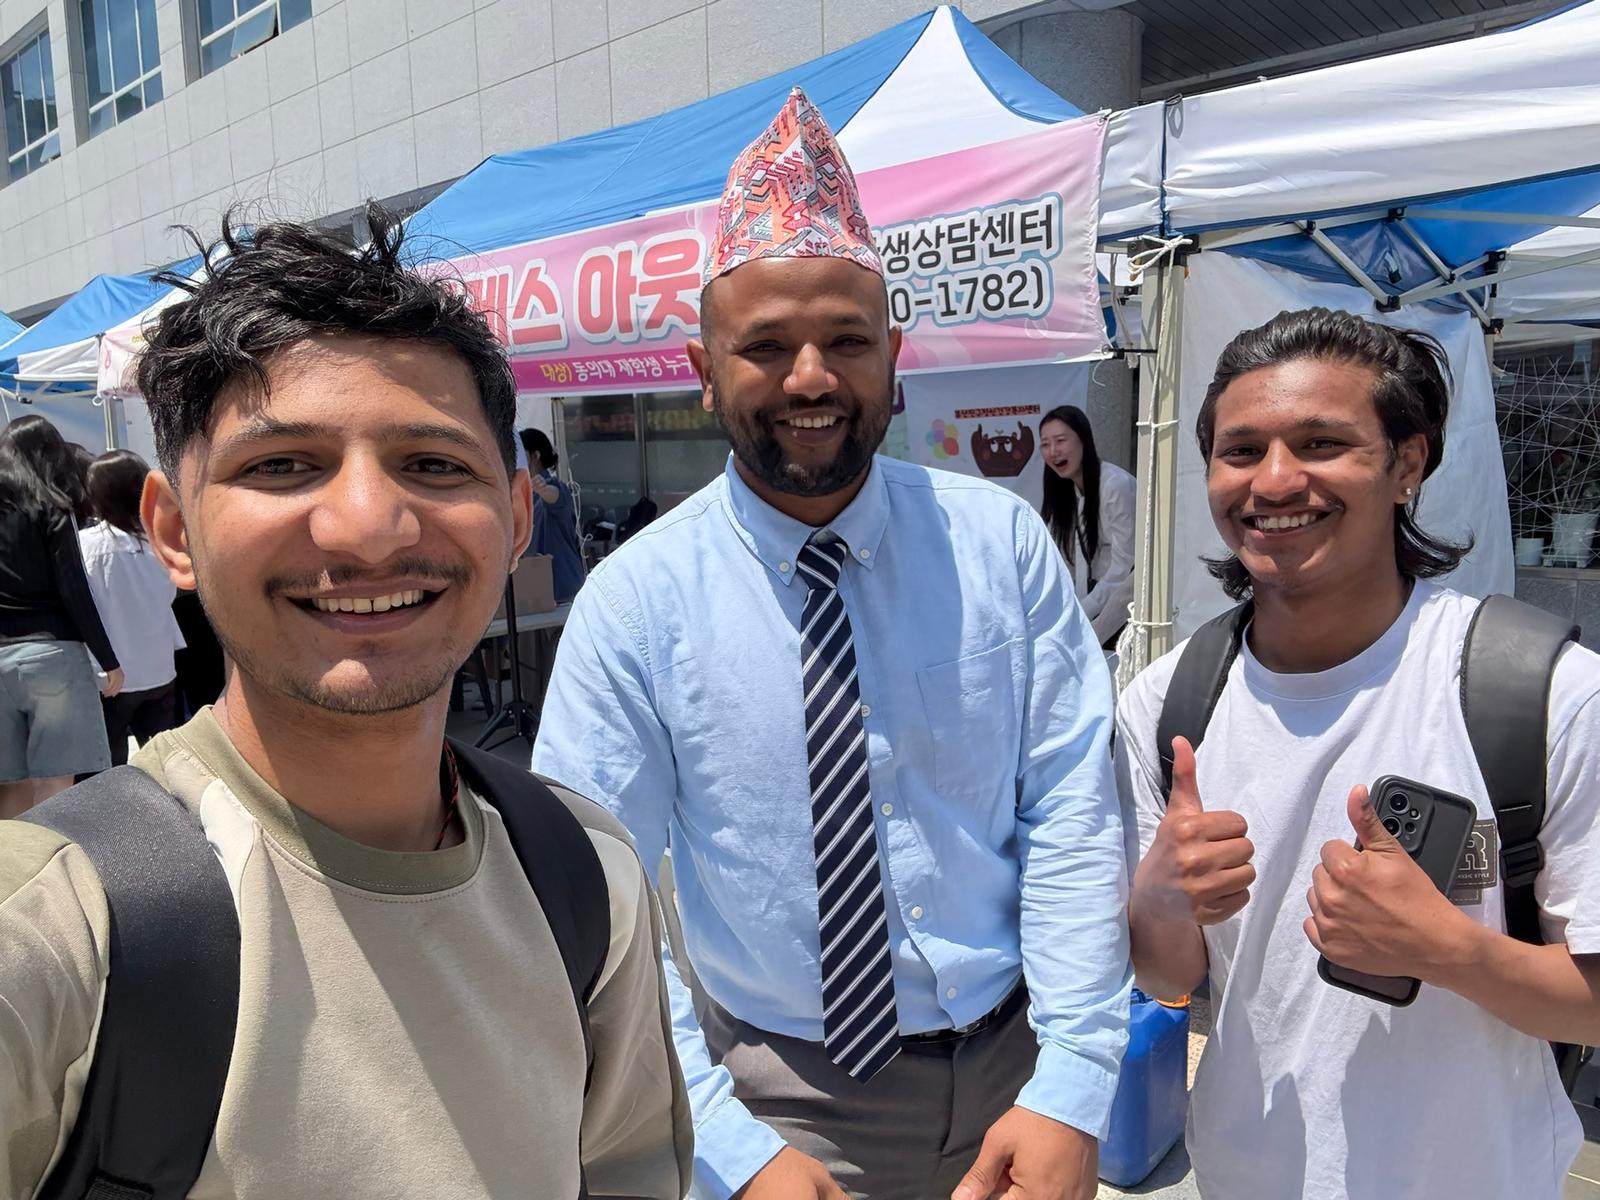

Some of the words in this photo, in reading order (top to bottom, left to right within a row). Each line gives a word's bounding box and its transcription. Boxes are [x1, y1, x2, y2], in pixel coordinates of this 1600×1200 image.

[876, 204, 1053, 275] 생상담센터
[447, 266, 563, 348] 레스
[578, 238, 701, 335] 아웃
[573, 360, 616, 382] 동의대
[615, 356, 662, 378] 재학생
